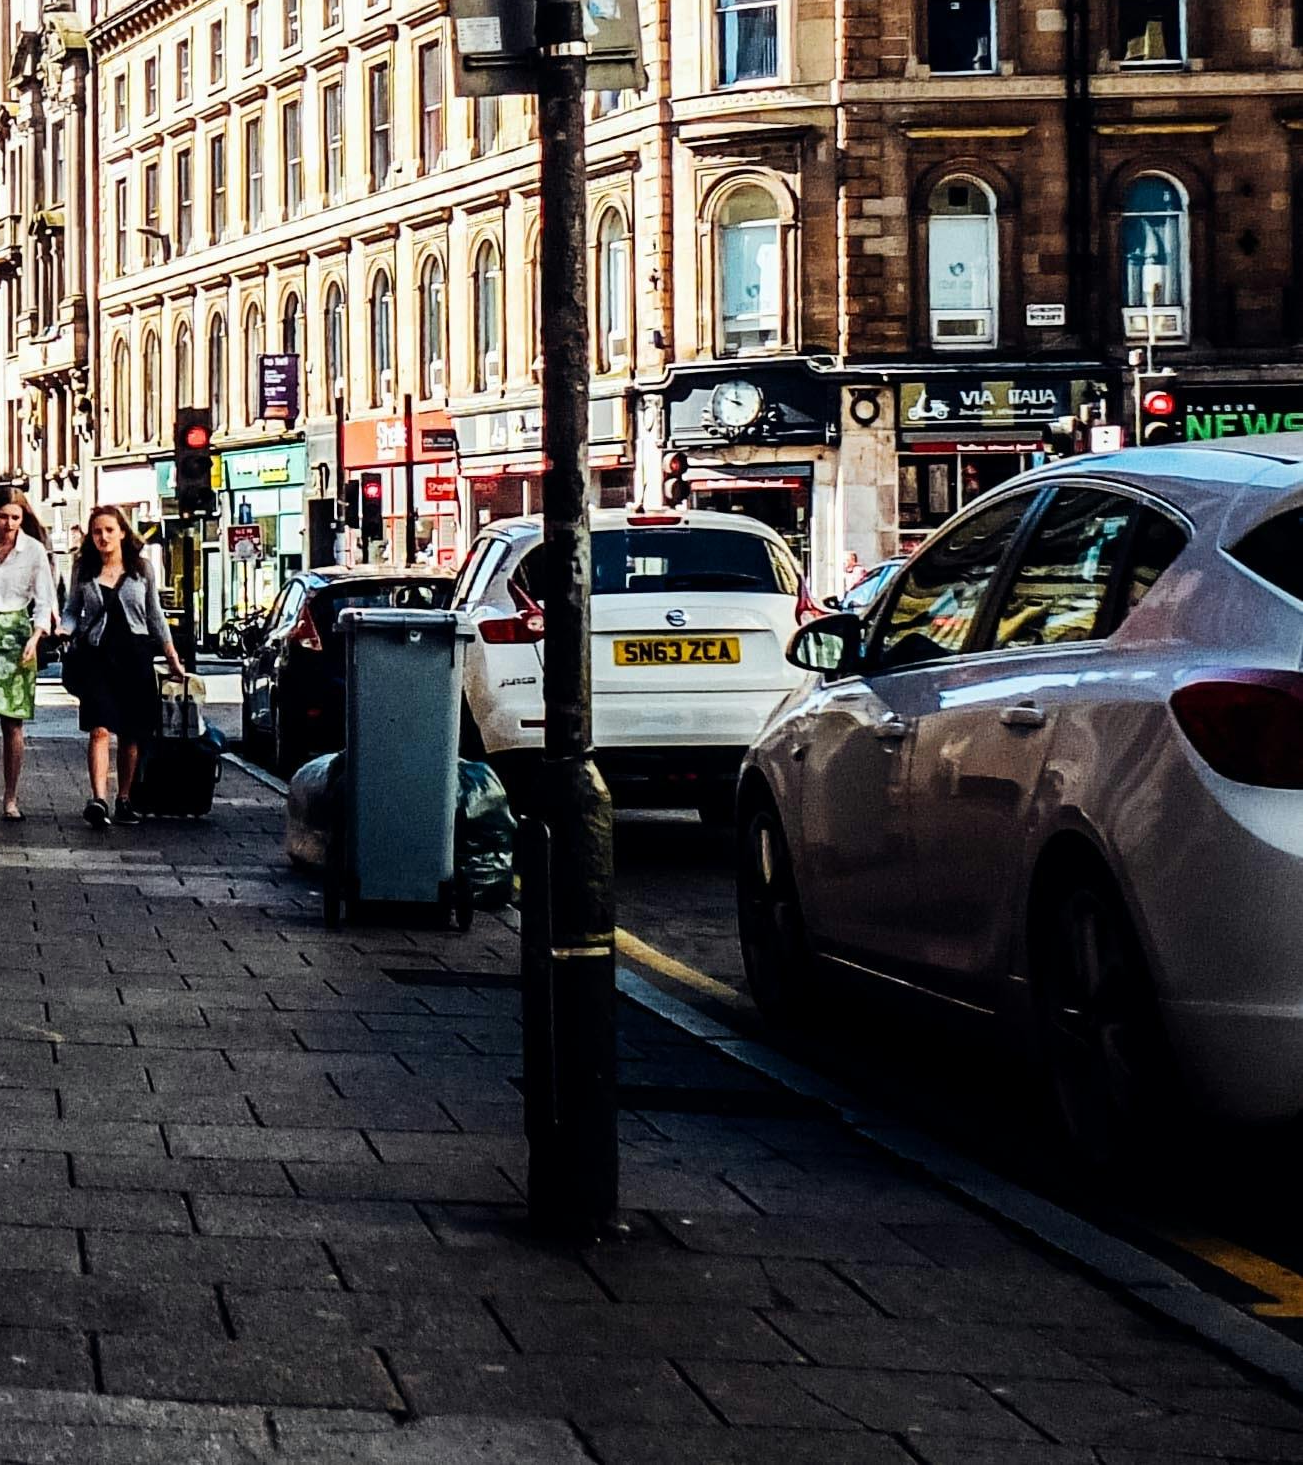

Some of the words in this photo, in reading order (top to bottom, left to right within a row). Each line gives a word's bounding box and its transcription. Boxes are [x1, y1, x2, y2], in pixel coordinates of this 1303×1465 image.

[959, 390, 996, 406] VIA
[1007, 389, 1057, 405] ITALIA
[623, 640, 683, 663] SN63
[687, 639, 732, 662] ZCA
